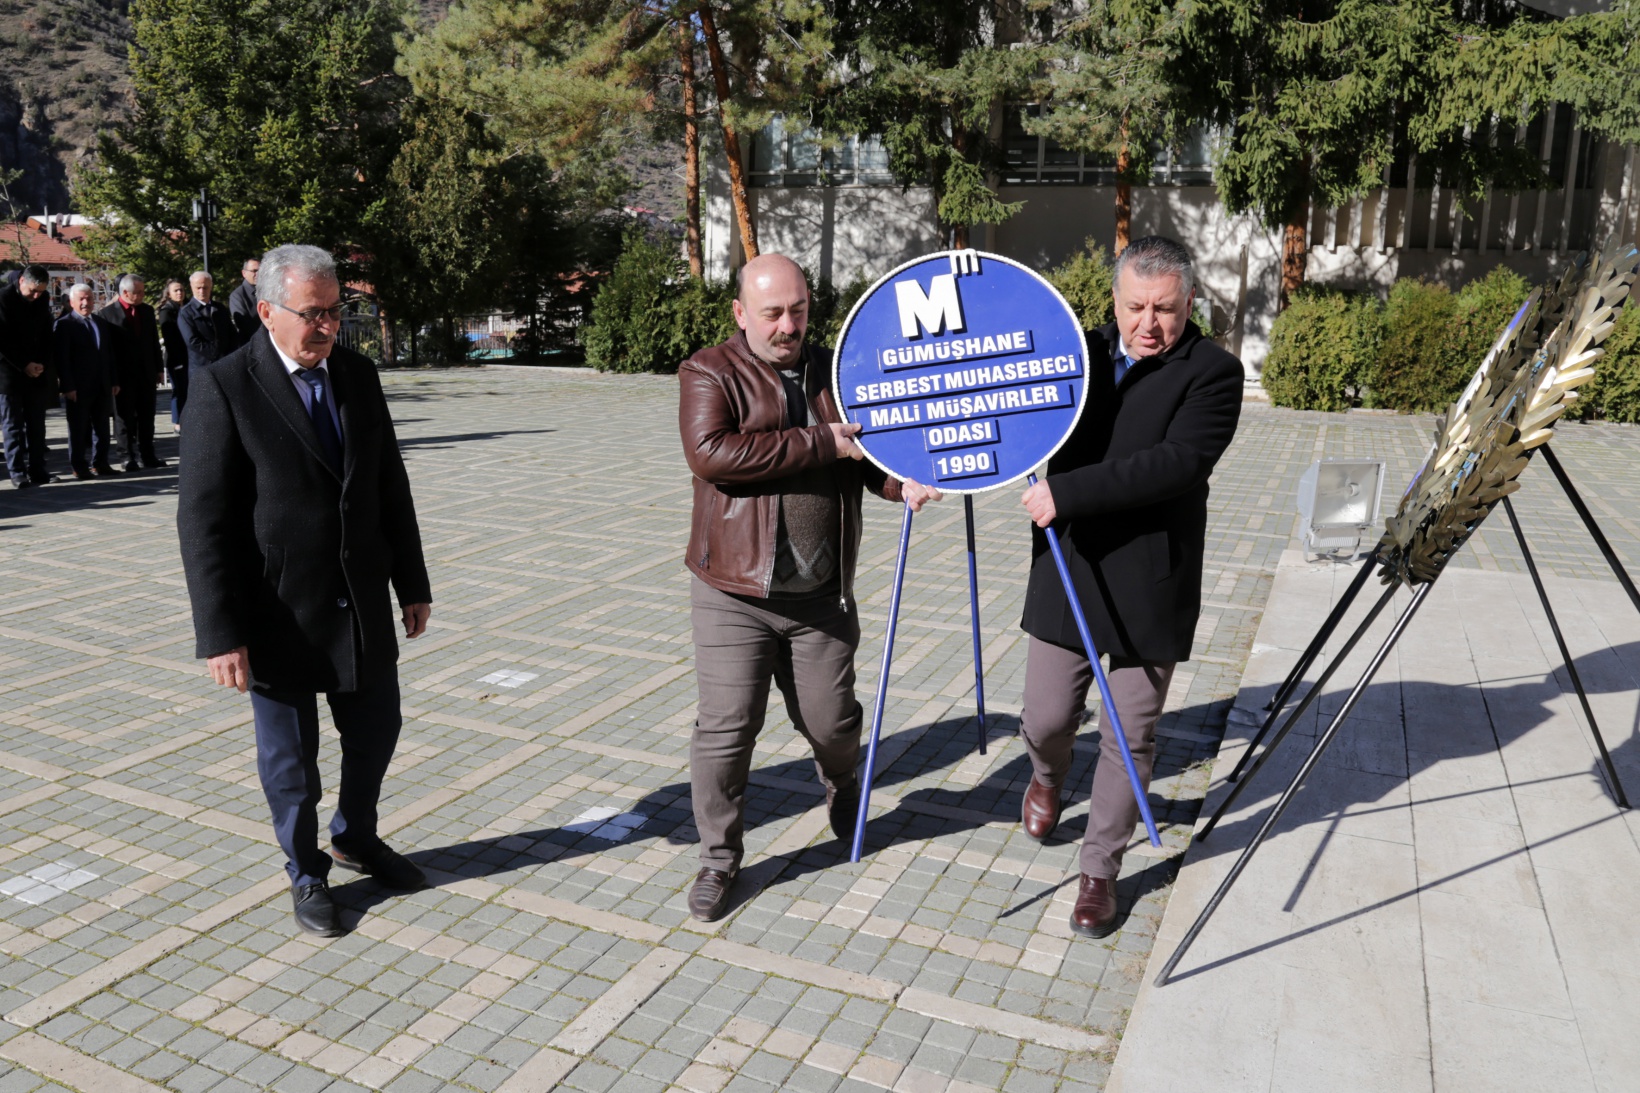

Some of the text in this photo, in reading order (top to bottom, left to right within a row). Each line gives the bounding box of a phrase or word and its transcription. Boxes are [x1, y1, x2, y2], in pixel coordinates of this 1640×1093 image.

[883, 331, 1027, 366] GÜMÜŞHANE
[855, 355, 1076, 402] SERBEST MUHASEBECİ
[870, 385, 1059, 427] MALİ MÜŞAVİRLER
[929, 422, 992, 446] ODASI
[937, 453, 990, 475] 1990
